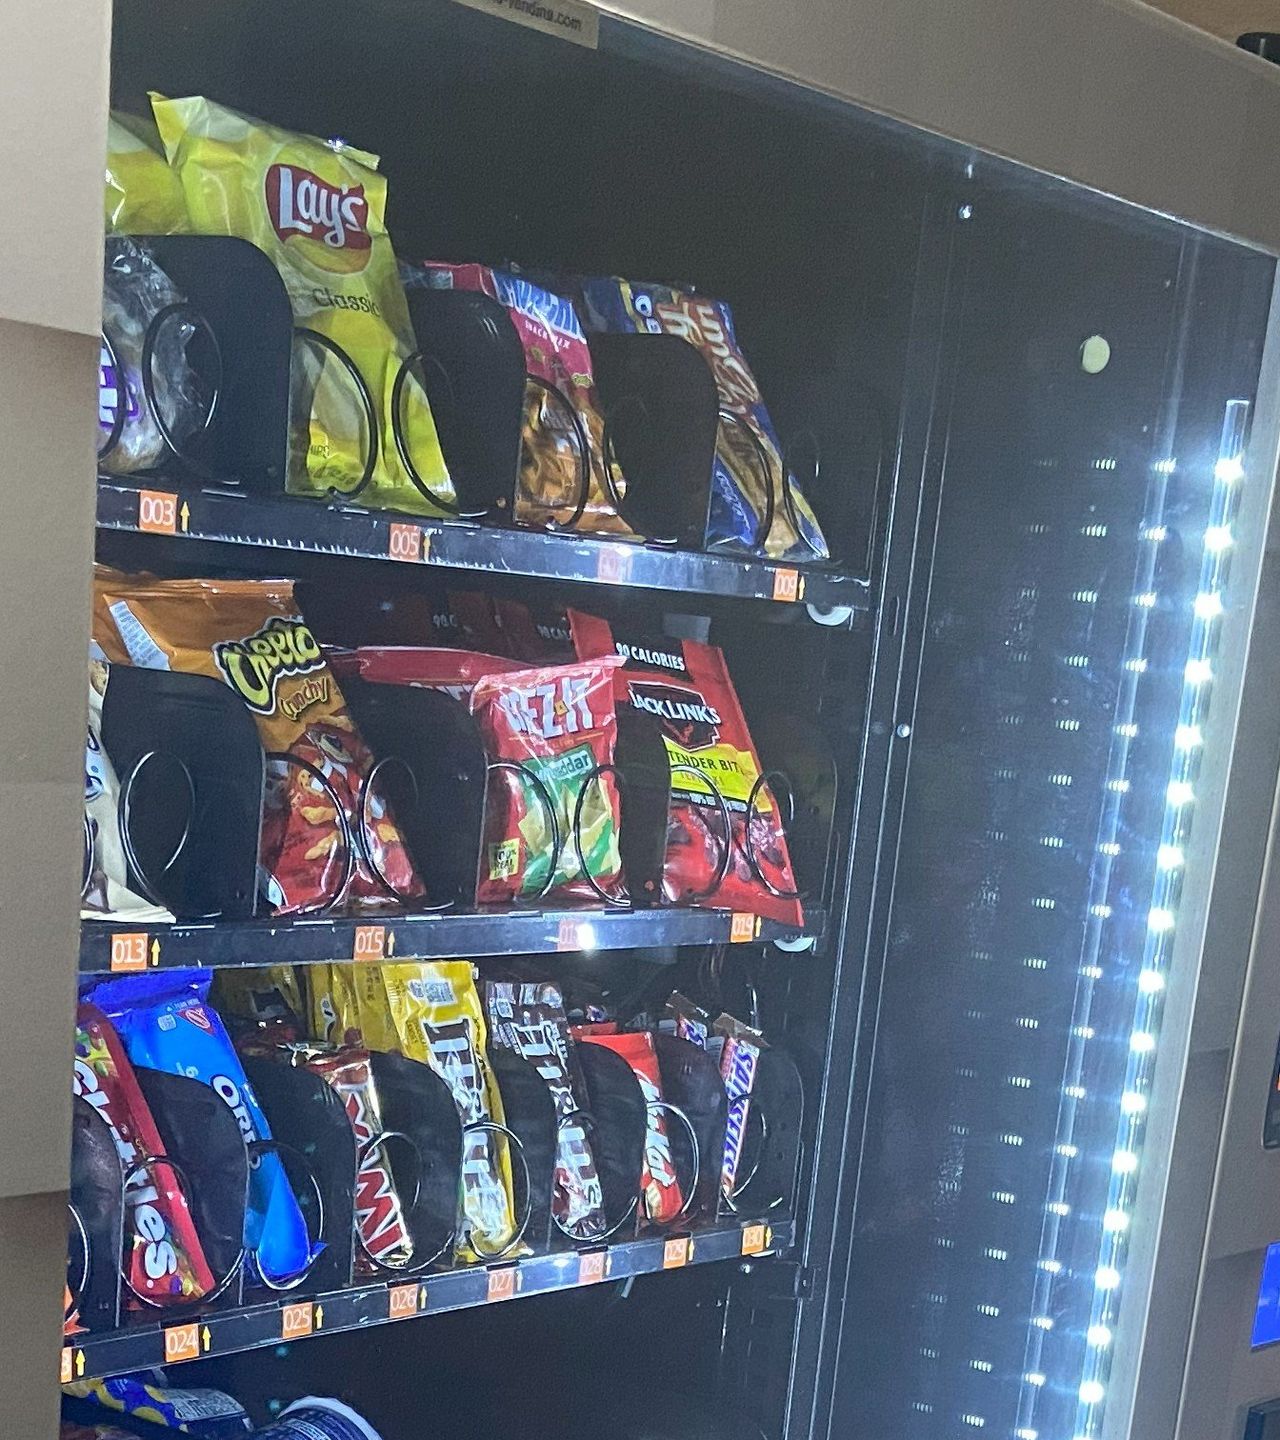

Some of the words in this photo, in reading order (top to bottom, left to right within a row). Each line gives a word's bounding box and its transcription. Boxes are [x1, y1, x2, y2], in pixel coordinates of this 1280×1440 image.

[279, 166, 365, 248] Lay's
[312, 288, 382, 317] Classic
[140, 496, 175, 526] 003
[391, 530, 419, 556] 005
[777, 573, 797, 596] 009
[221, 619, 321, 706] Cheeto
[616, 642, 630, 658] 90
[631, 646, 686, 672] CALORIES
[628, 689, 668, 720] JACK
[668, 750, 717, 770] TENDER
[732, 916, 753, 936] 019
[111, 937, 147, 964] 013
[355, 927, 384, 953] 015
[581, 1254, 602, 1274] 028
[488, 1271, 513, 1294] 027
[390, 1288, 417, 1312] 026
[284, 1307, 311, 1331] 025
[166, 1328, 198, 1356] 024
